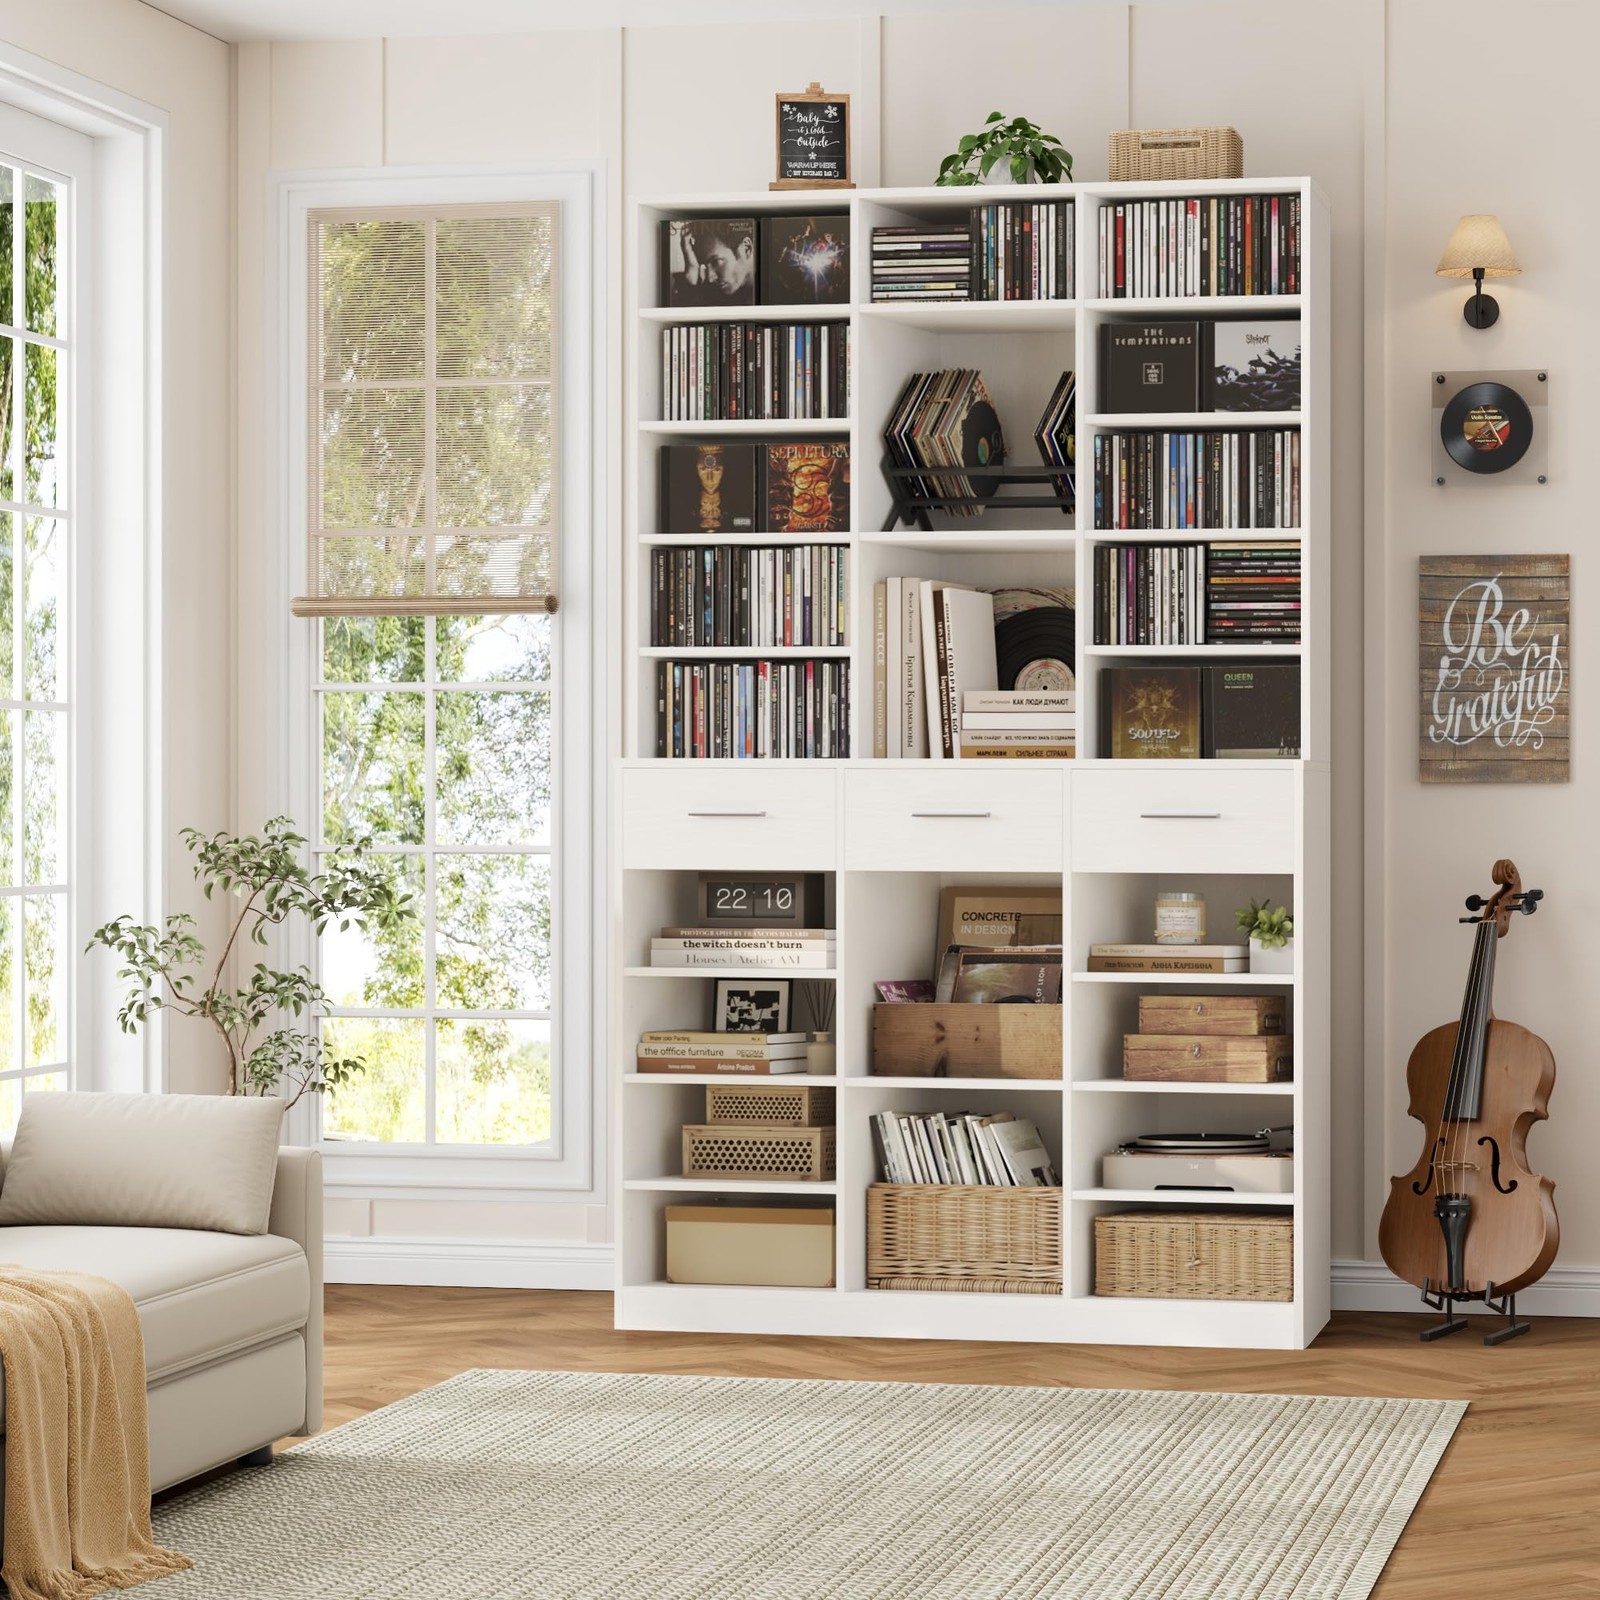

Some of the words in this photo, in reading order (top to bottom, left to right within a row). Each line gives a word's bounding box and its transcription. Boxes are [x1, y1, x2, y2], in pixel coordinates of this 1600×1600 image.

[1144, 328, 1163, 336] THE
[1115, 337, 1192, 345] TEMPTATIONS
[770, 445, 849, 459] SEPULTURA
[1443, 572, 1540, 668] Be
[905, 655, 915, 688] Братья
[947, 648, 956, 694] ГОВОРИ
[1224, 673, 1254, 682] QUEEN
[1429, 634, 1563, 750] Grateful
[1025, 698, 1043, 706] ЛЮДИ
[1044, 698, 1069, 706] ДУМАЮТ
[905, 690, 915, 748] Карамазовы
[951, 718, 959, 735] БОГ
[1046, 750, 1068, 758] СТРАХА
[716, 888, 748, 909] 22
[763, 887, 792, 910] 10
[961, 911, 1022, 922] CONCRETE
[960, 924, 972, 934] IN
[974, 925, 1016, 935] DESIGN
[683, 940, 701, 949] the
[702, 940, 733, 949] witch
[776, 940, 803, 949] burn
[686, 954, 727, 964] Houses
[735, 955, 776, 965] Atelier
[1151, 961, 1172, 969] АННА
[1173, 961, 1213, 970] КАРЕНИНА
[1038, 967, 1046, 985] LEON
[644, 1047, 658, 1056] the
[688, 1047, 724, 1057] furniture
